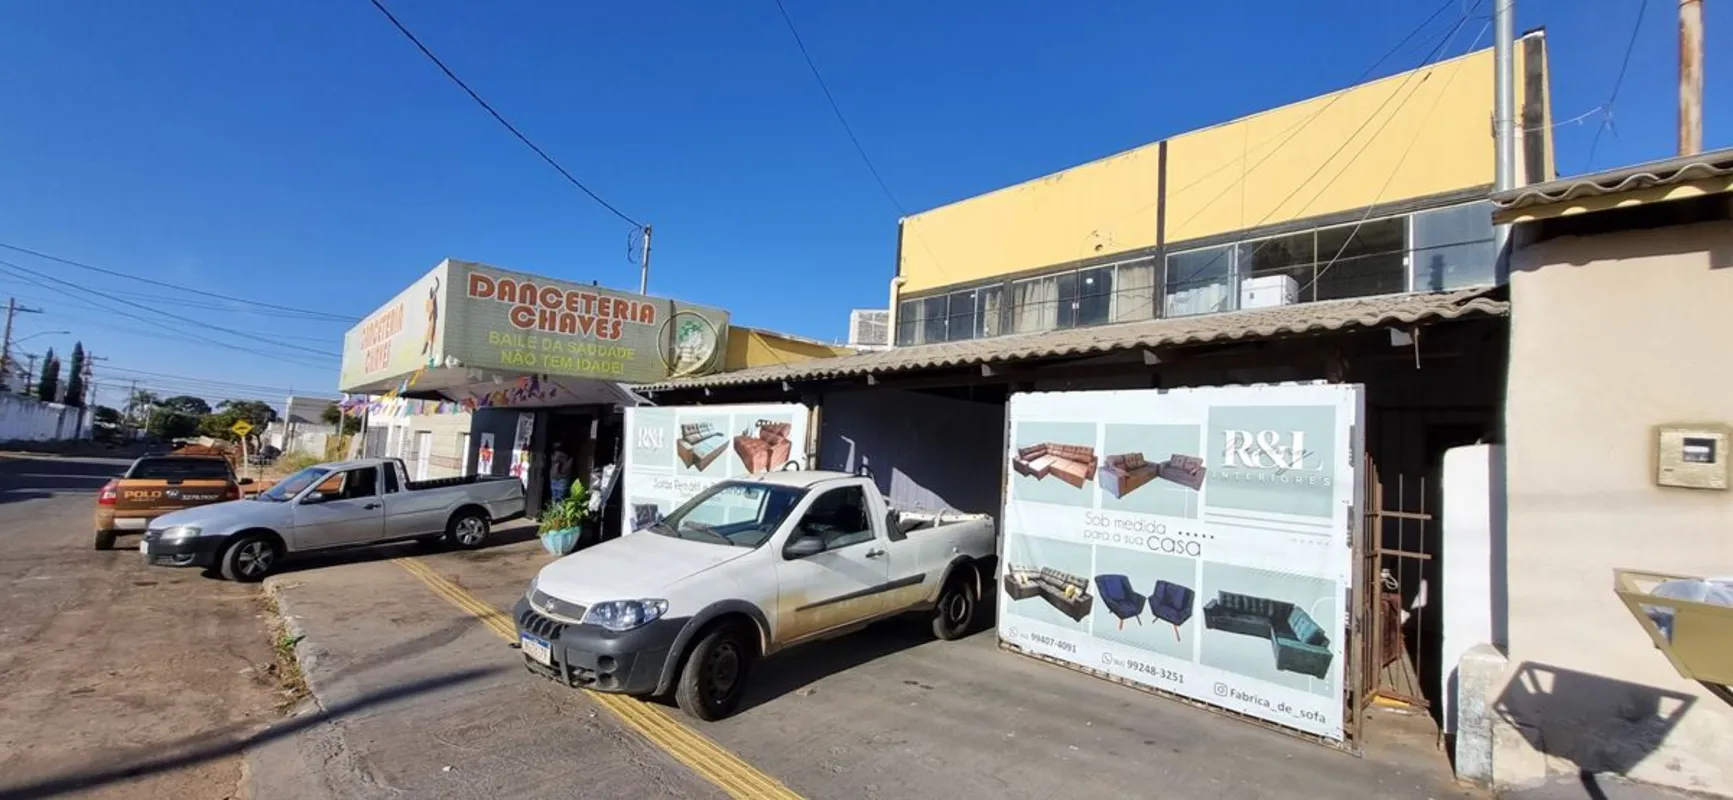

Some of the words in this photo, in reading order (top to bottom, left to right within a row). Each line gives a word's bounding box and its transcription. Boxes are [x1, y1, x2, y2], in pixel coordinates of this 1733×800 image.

[468, 272, 657, 324] DANCETERIA
[509, 305, 625, 341] CHAVES
[489, 331, 537, 349] BAILE
[541, 338, 563, 351] DA
[567, 342, 636, 360] SAUDADE
[501, 349, 537, 366] NÃO
[540, 354, 572, 369] TEM
[1220, 429, 1324, 471] R&L
[1212, 471, 1331, 486] INTERIORES
[124, 490, 162, 499] POLO
[1084, 510, 1110, 527] Sob
[1114, 519, 1166, 535] medida
[1084, 529, 1110, 541] para
[1123, 535, 1144, 545] sua
[1146, 535, 1201, 557] casa
[1127, 659, 1184, 684] 99248-3251
[1229, 688, 1327, 723] Fabrica_de_sofa
